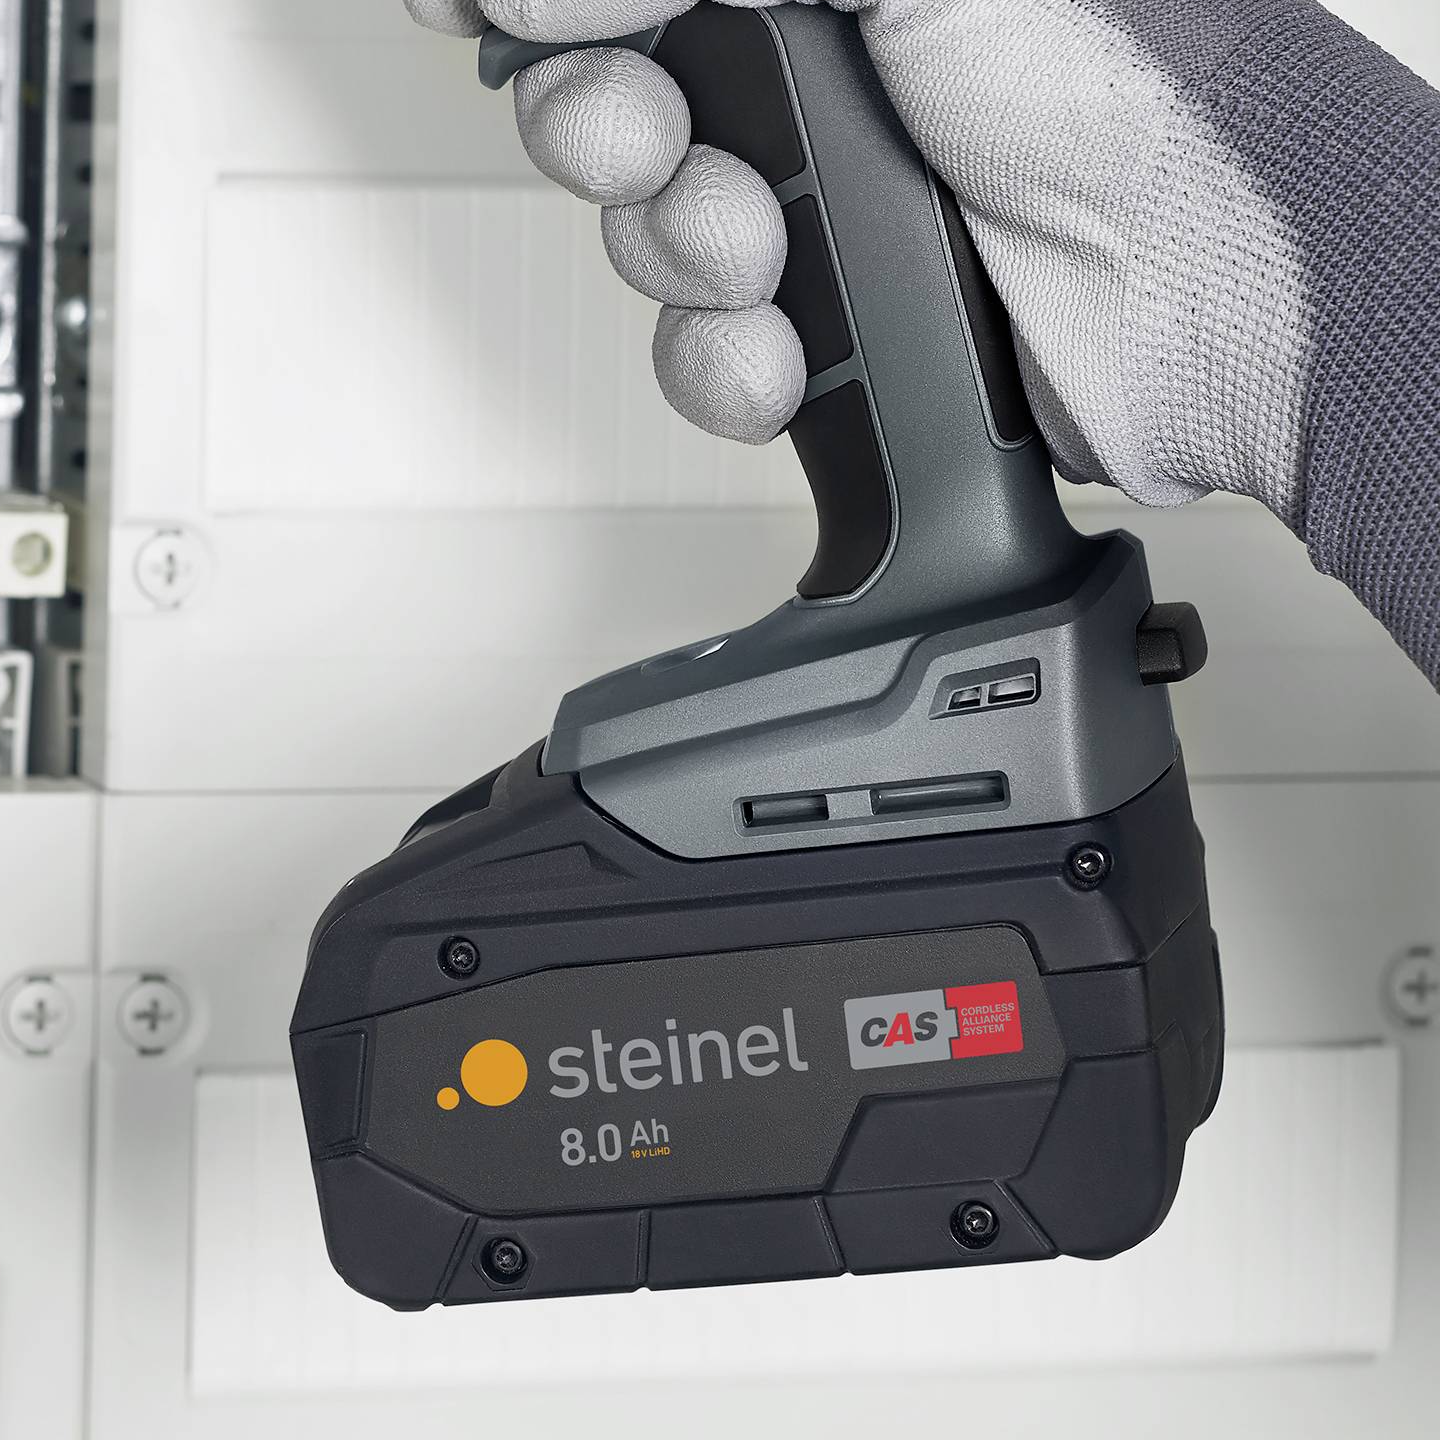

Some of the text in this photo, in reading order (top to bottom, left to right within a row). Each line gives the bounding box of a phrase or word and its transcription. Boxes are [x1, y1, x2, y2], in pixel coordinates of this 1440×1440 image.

[961, 1002, 1015, 1017] CORDLESS
[962, 1012, 1012, 1026] ALLIANCE
[860, 1011, 938, 1048] CAS
[963, 1024, 1005, 1037] SYSTEM
[548, 1007, 809, 1099] steinel
[560, 1118, 669, 1166] 8.0 Ah
